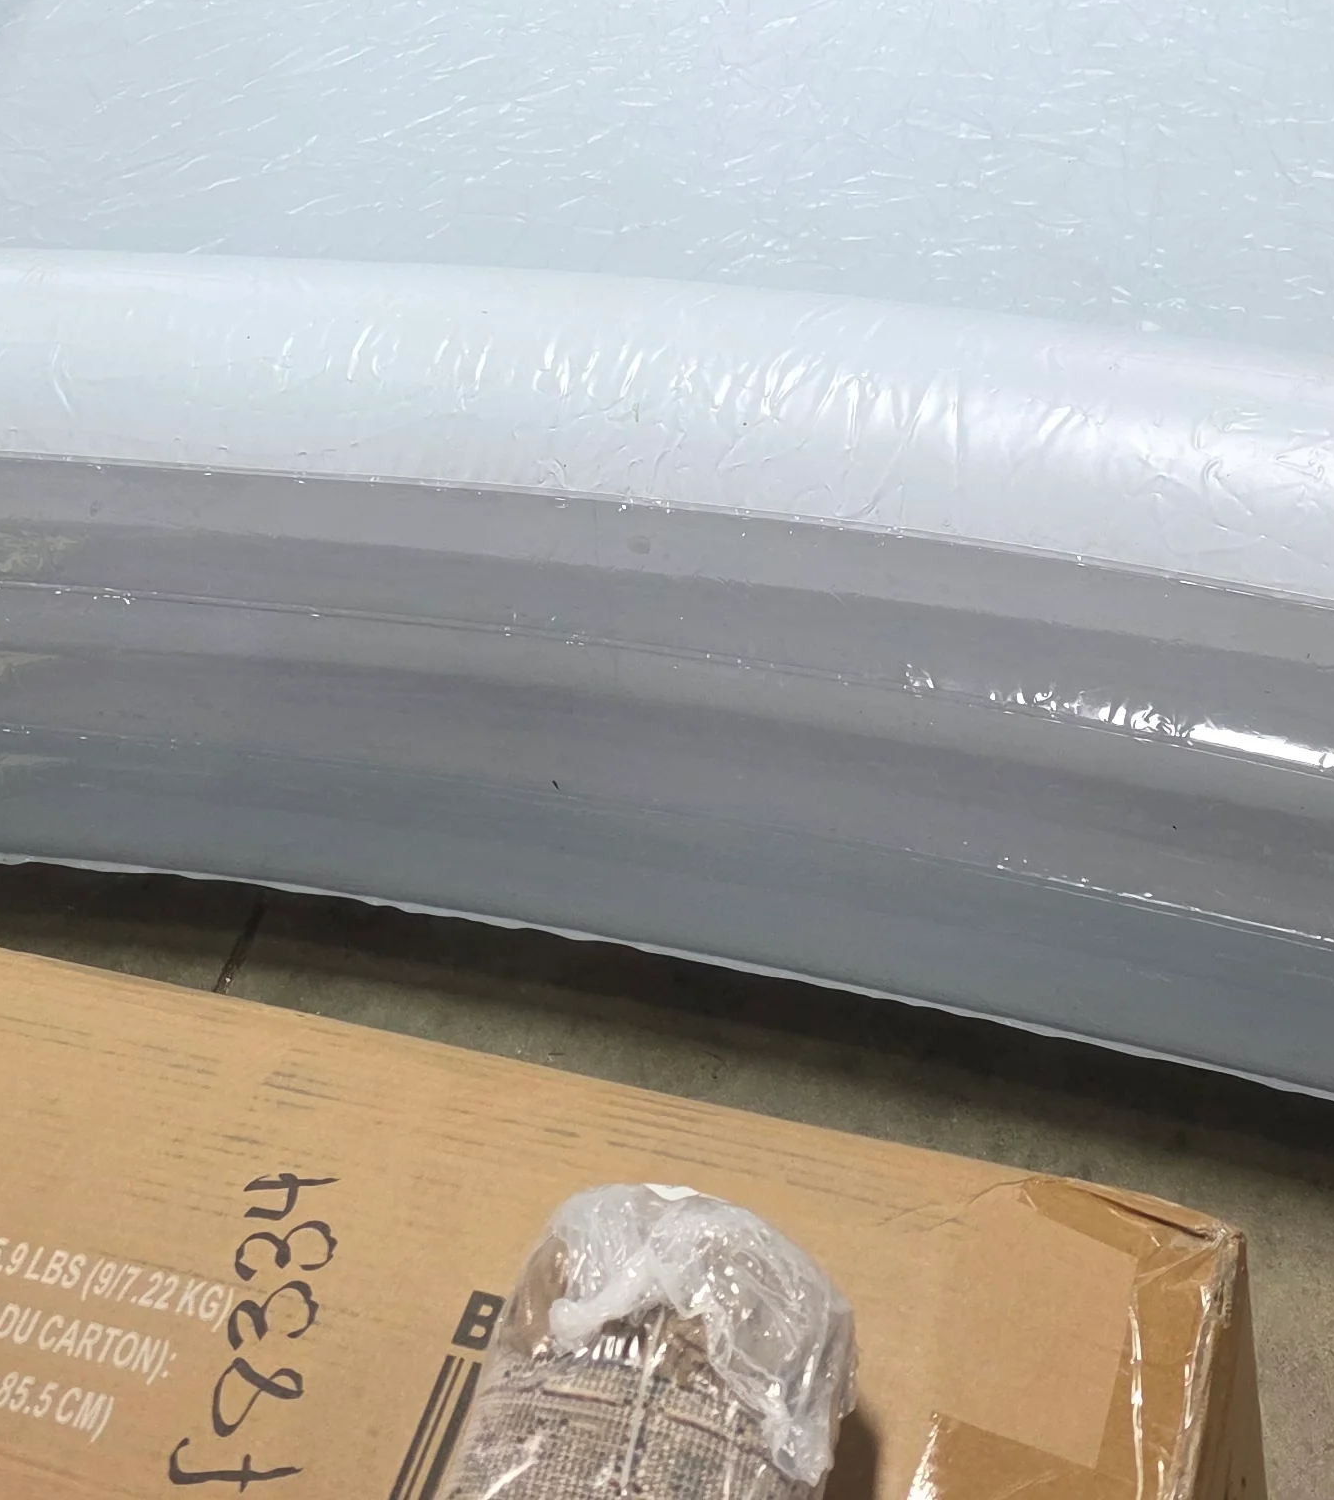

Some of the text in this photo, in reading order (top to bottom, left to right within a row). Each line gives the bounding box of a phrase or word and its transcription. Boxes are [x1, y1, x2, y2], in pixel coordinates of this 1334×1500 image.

[25, 1246, 87, 1289] LBS
[82, 1258, 179, 1310] (9/7.22
[175, 1277, 235, 1333] KG)
[38, 1315, 178, 1385] CARTON):
[55, 1387, 115, 1442] CM)
